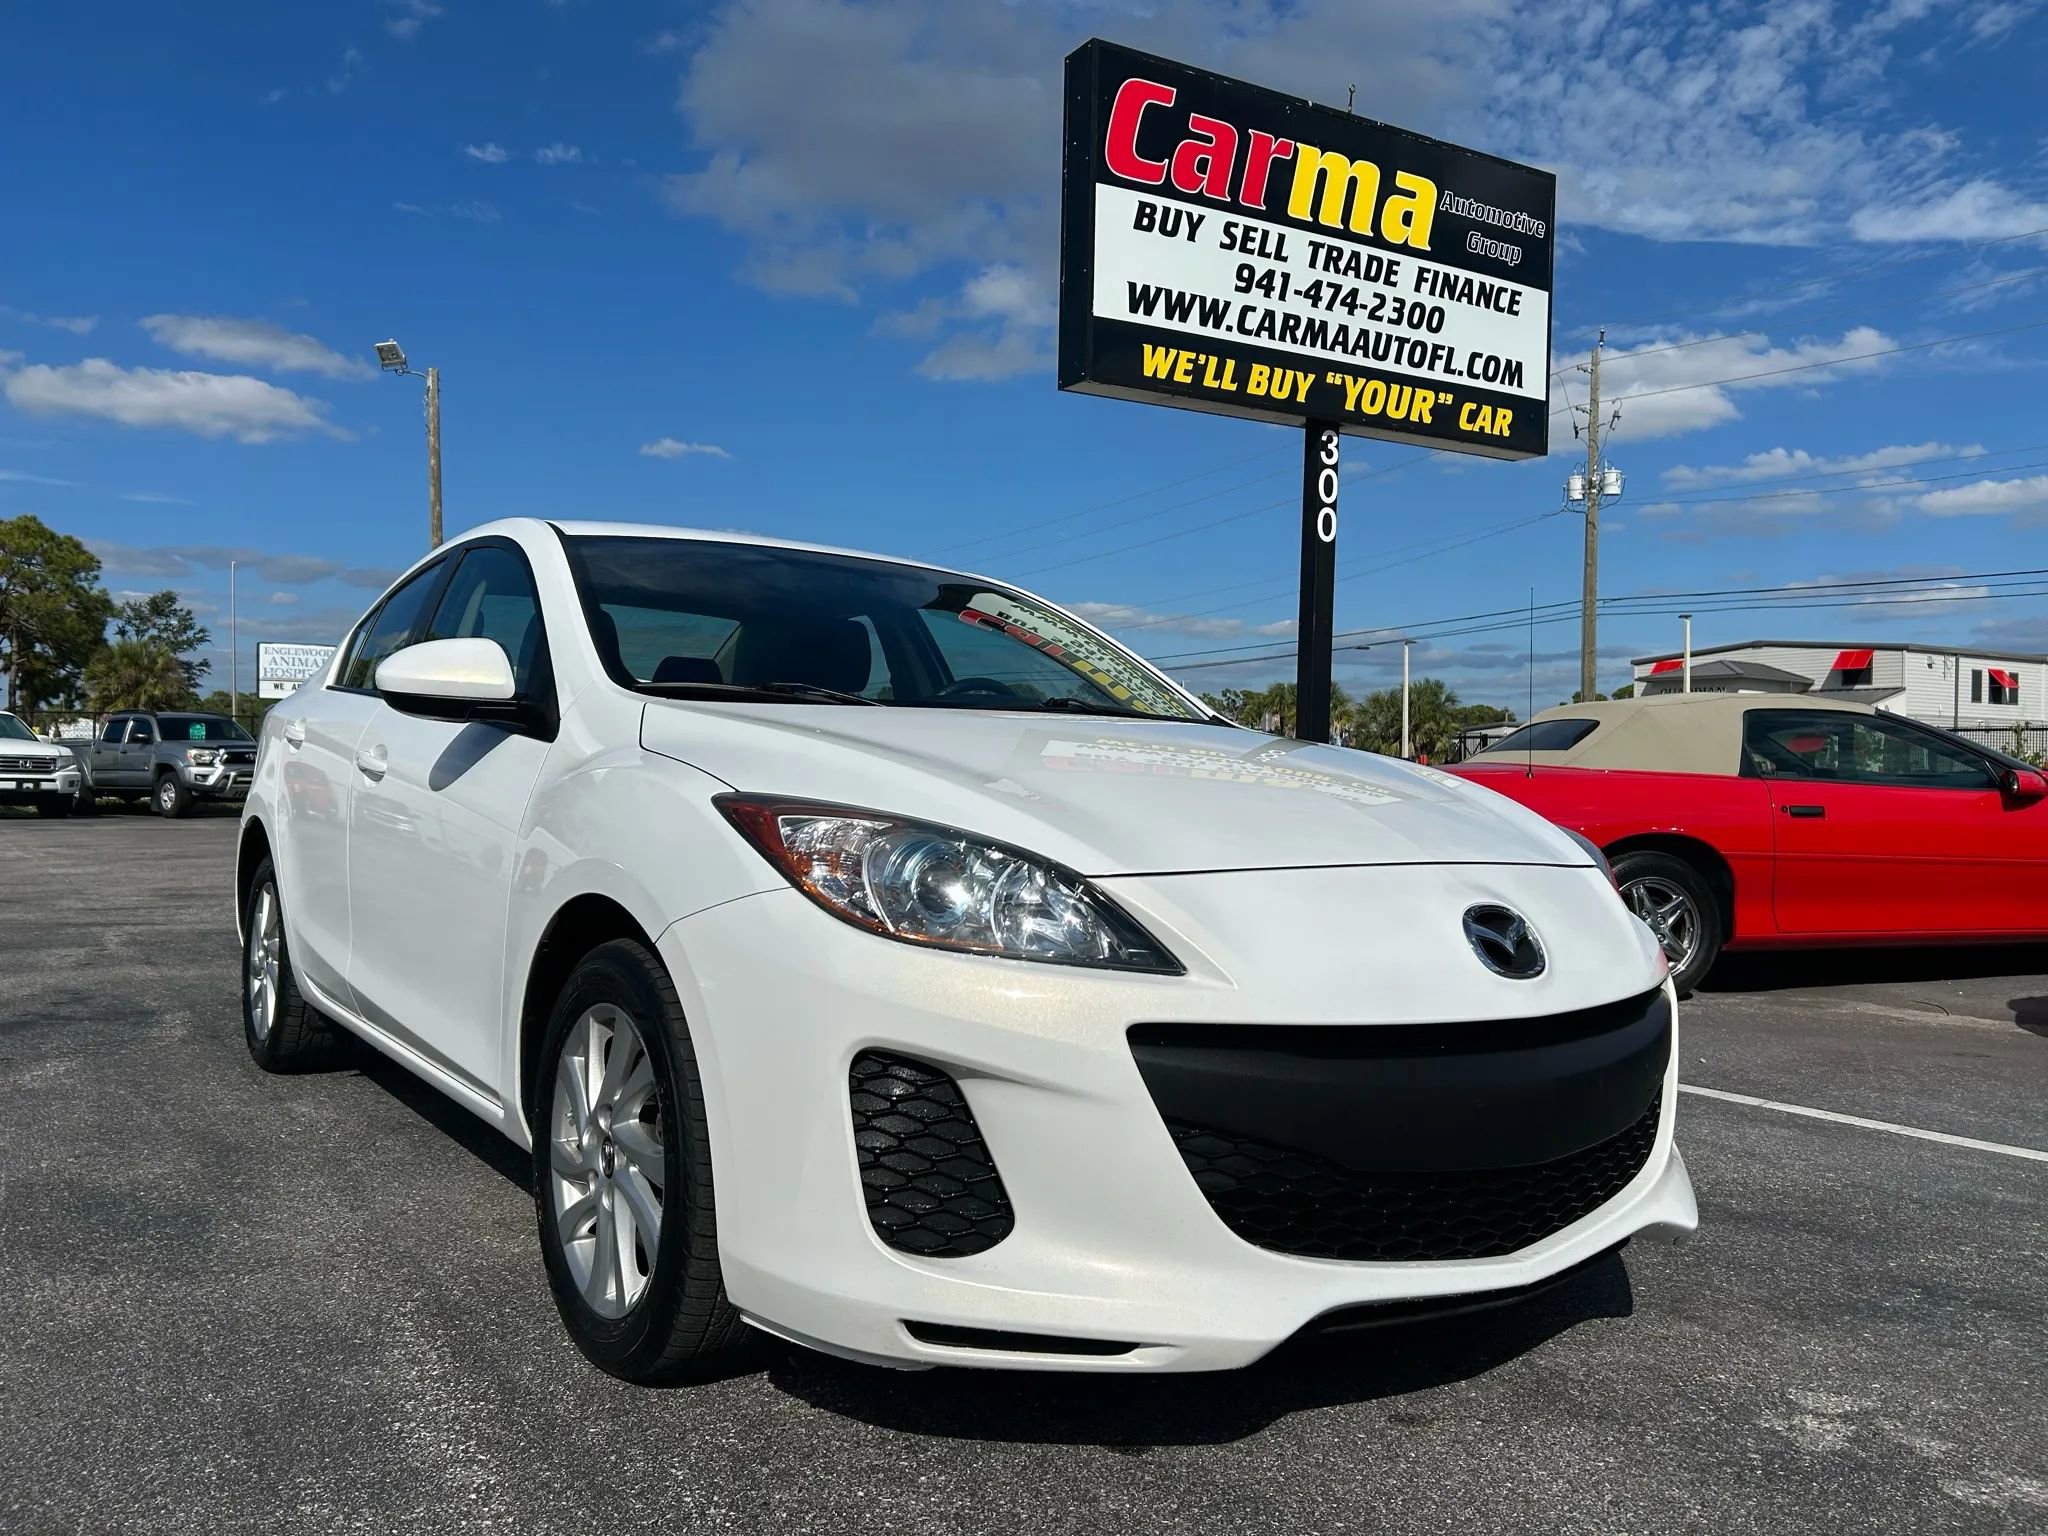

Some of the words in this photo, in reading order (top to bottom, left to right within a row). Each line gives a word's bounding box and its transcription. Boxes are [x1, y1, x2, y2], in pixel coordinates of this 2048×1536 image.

[1104, 77, 1438, 251] Carma
[1133, 200, 1205, 242] BUY
[1219, 220, 1289, 263] SELL
[1308, 240, 1401, 288] TRADE
[1414, 266, 1523, 317] FINANCE
[1440, 190, 1545, 238] Automotive
[1466, 231, 1522, 266] Group
[1126, 280, 1524, 389] WWW.CARMAAUTOFL.COM
[1234, 263, 1446, 334] 941-474-2300
[1142, 343, 1238, 392] WE'LL
[1246, 362, 1316, 403] BUY
[1325, 371, 1454, 424] "YOUR"
[1458, 401, 1514, 437] CAR
[1317, 429, 1339, 543] 300
[264, 647, 333, 657] ENGLEWOOD
